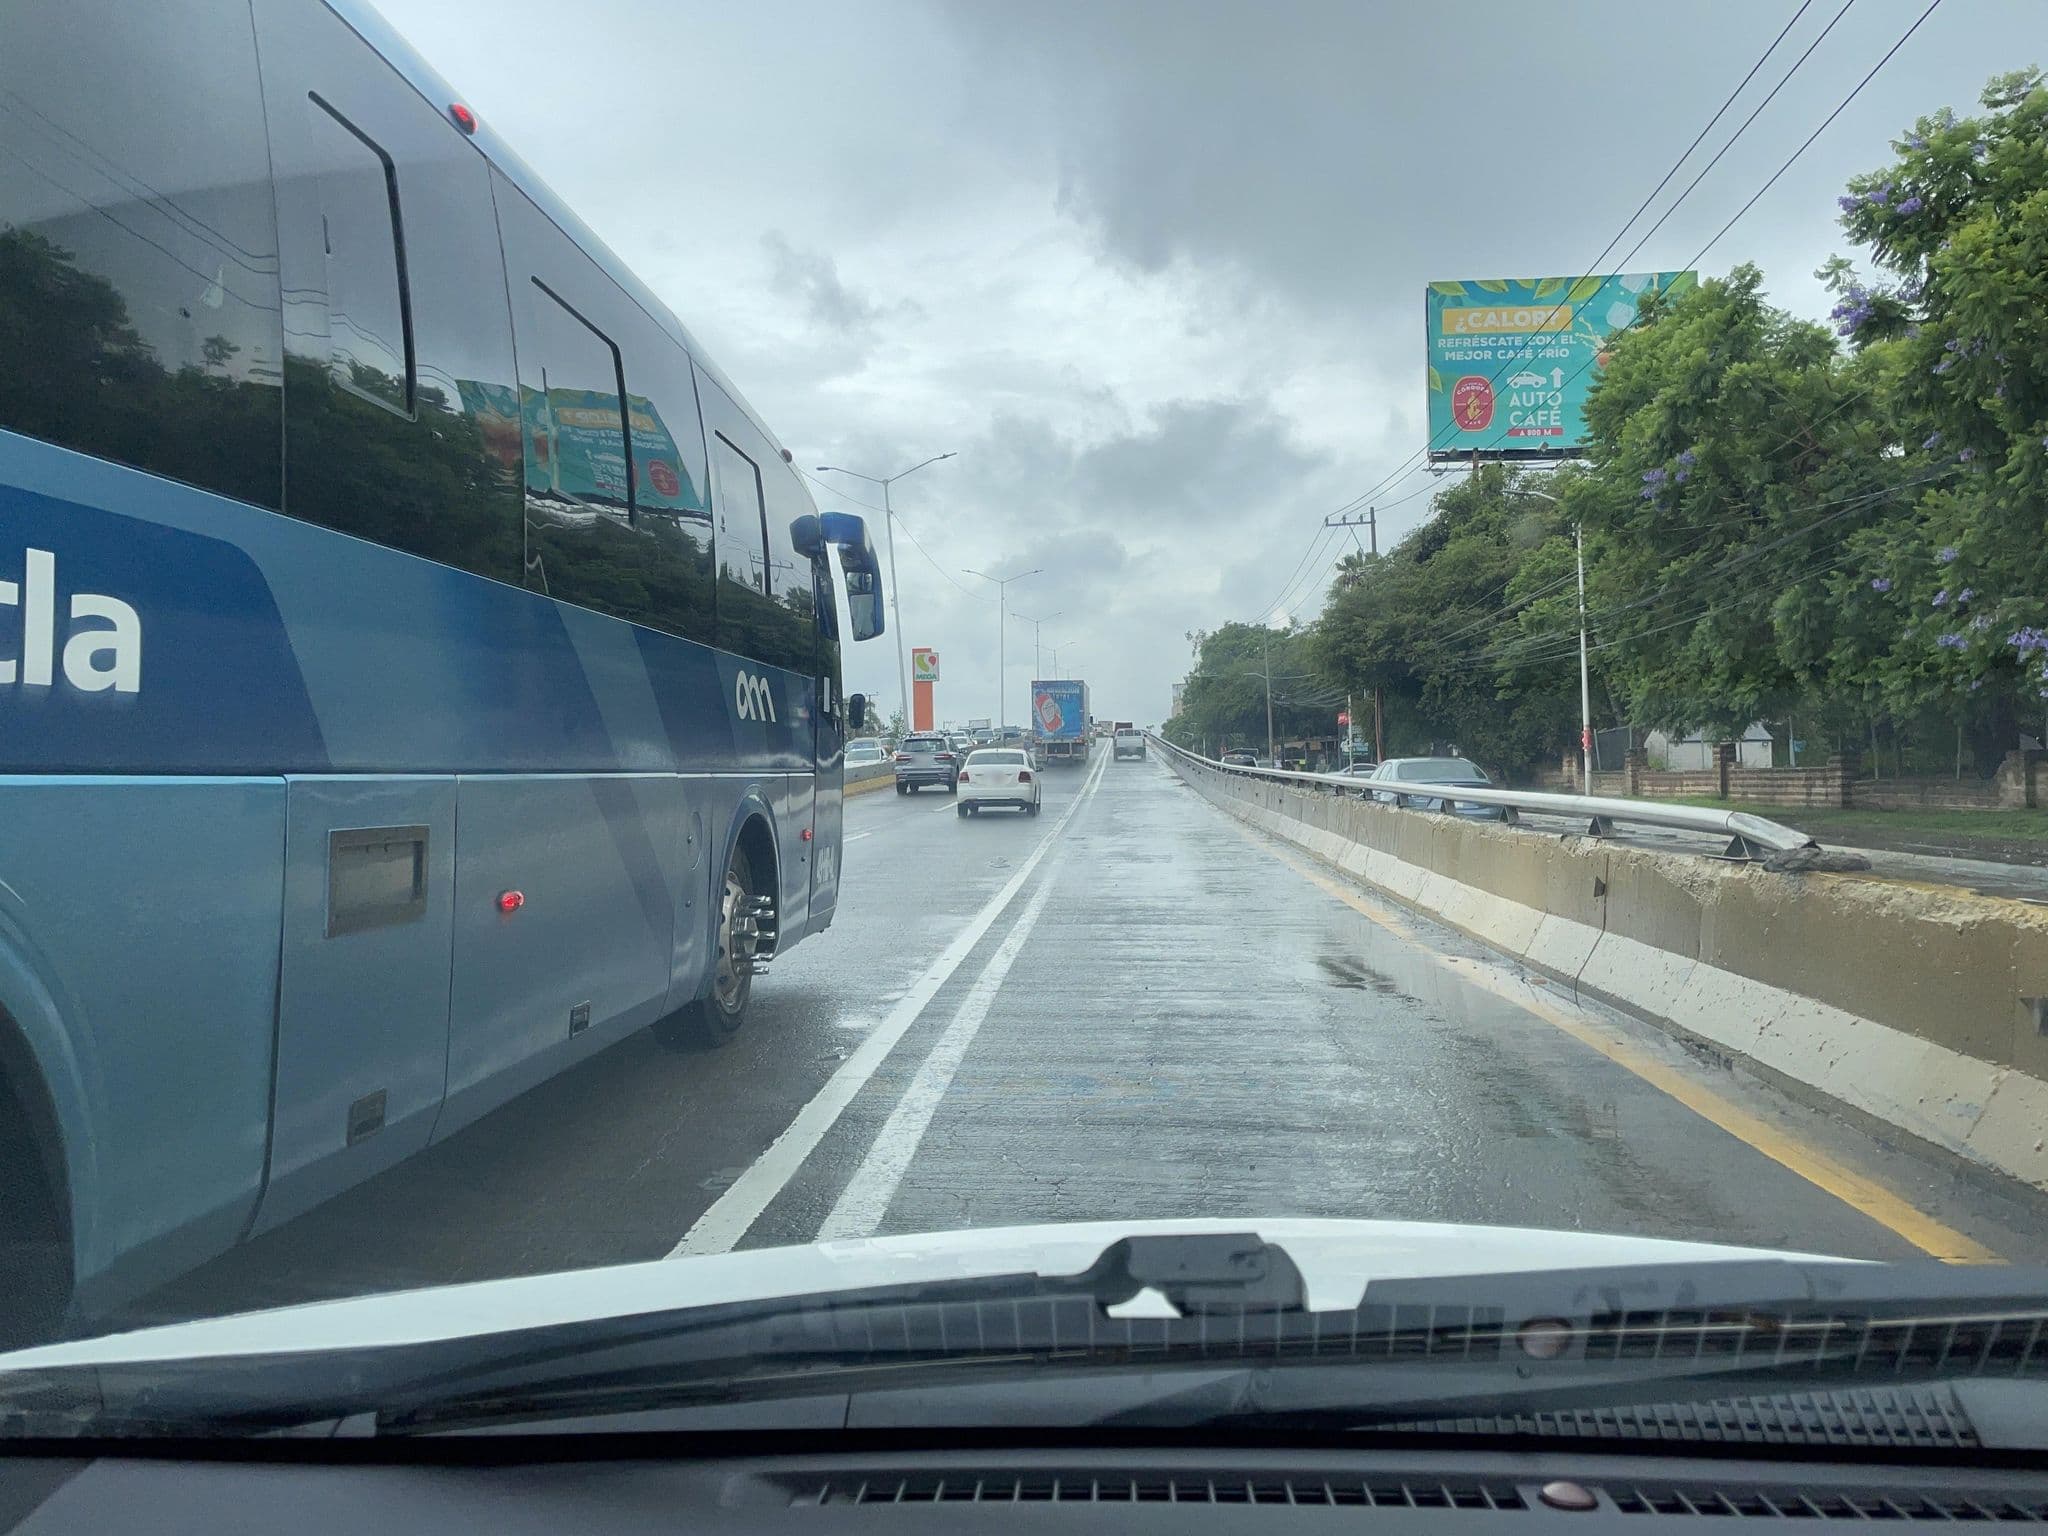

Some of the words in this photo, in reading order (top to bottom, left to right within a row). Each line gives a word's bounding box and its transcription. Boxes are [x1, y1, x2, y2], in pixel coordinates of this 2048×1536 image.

[1455, 310, 1560, 333] ¿CALOR?
[1438, 335, 1523, 348] REFRÉSCATE
[1528, 335, 1556, 346] CON
[1560, 335, 1577, 345] EL
[1445, 350, 1493, 361] MEJOR
[1497, 346, 1533, 360] CAFÉ
[1538, 346, 1570, 358] FRÍO
[1509, 391, 1562, 407] AUTO
[1510, 406, 1561, 426] CAFÉ
